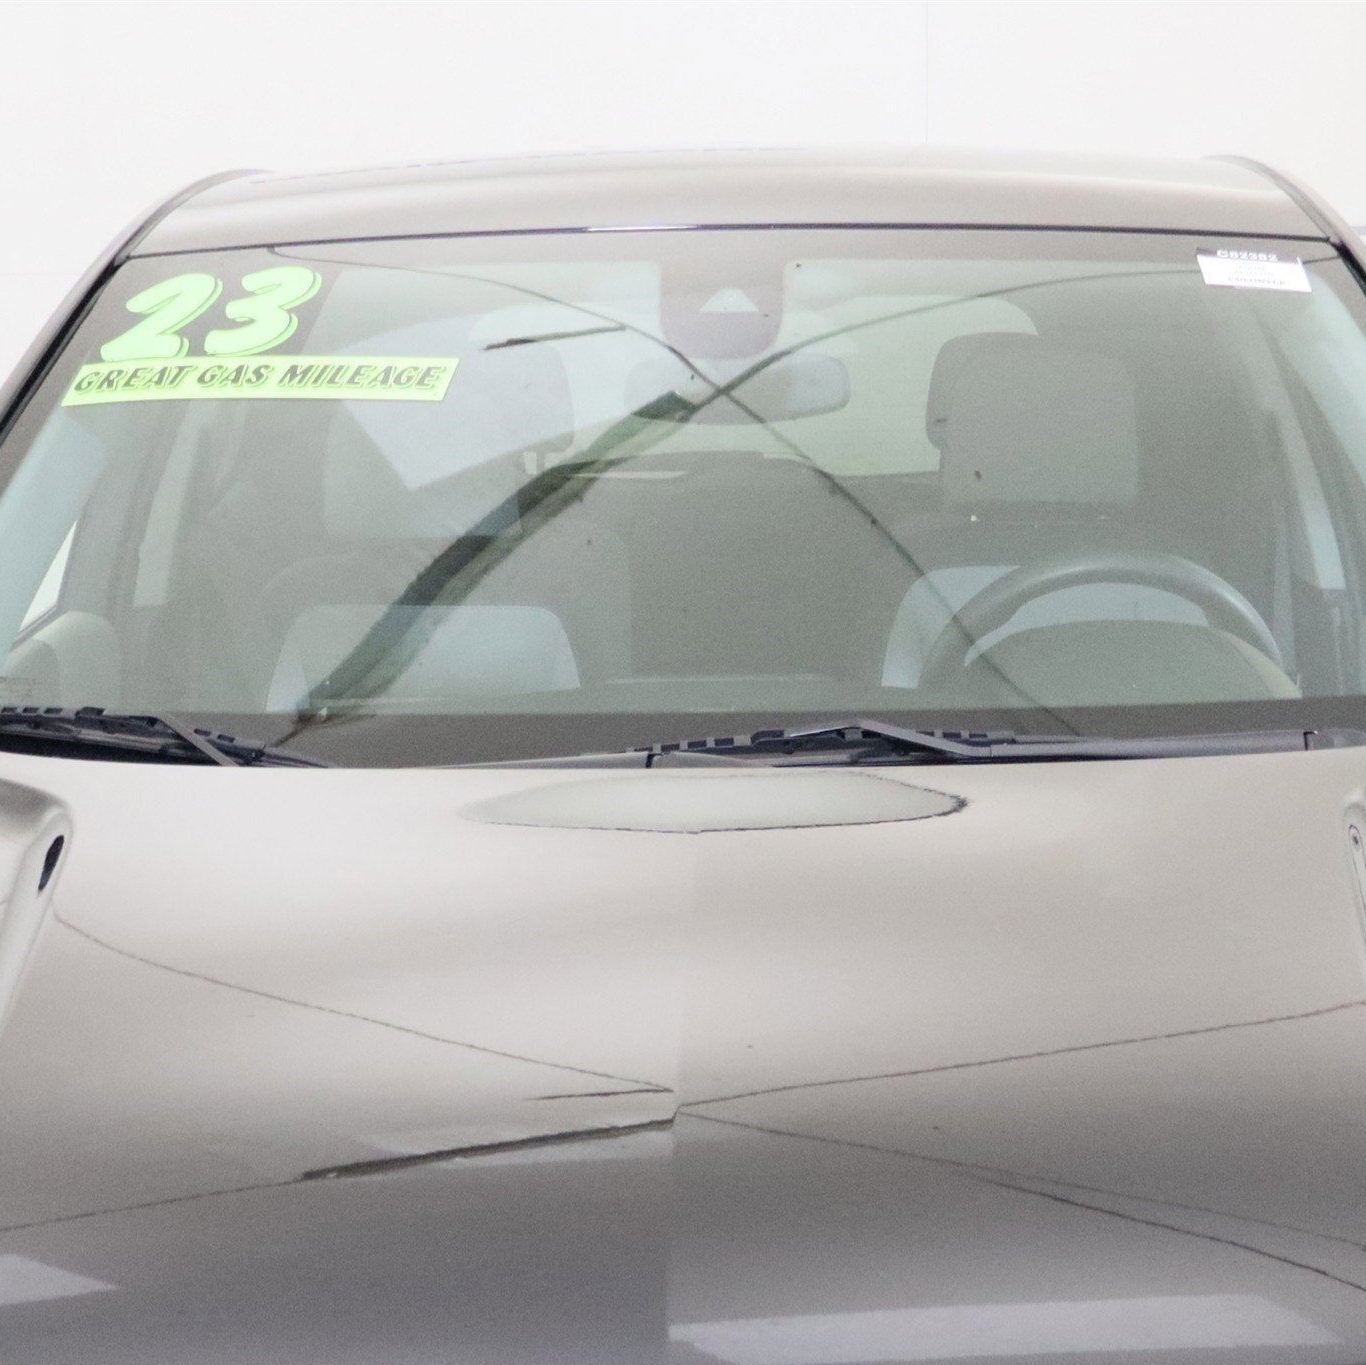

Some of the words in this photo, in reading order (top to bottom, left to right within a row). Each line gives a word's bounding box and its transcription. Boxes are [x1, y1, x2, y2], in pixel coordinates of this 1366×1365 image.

[100, 265, 322, 362] 23
[74, 364, 197, 393] GREAT
[196, 363, 273, 390] GAS
[278, 364, 449, 391] MILEAGE
